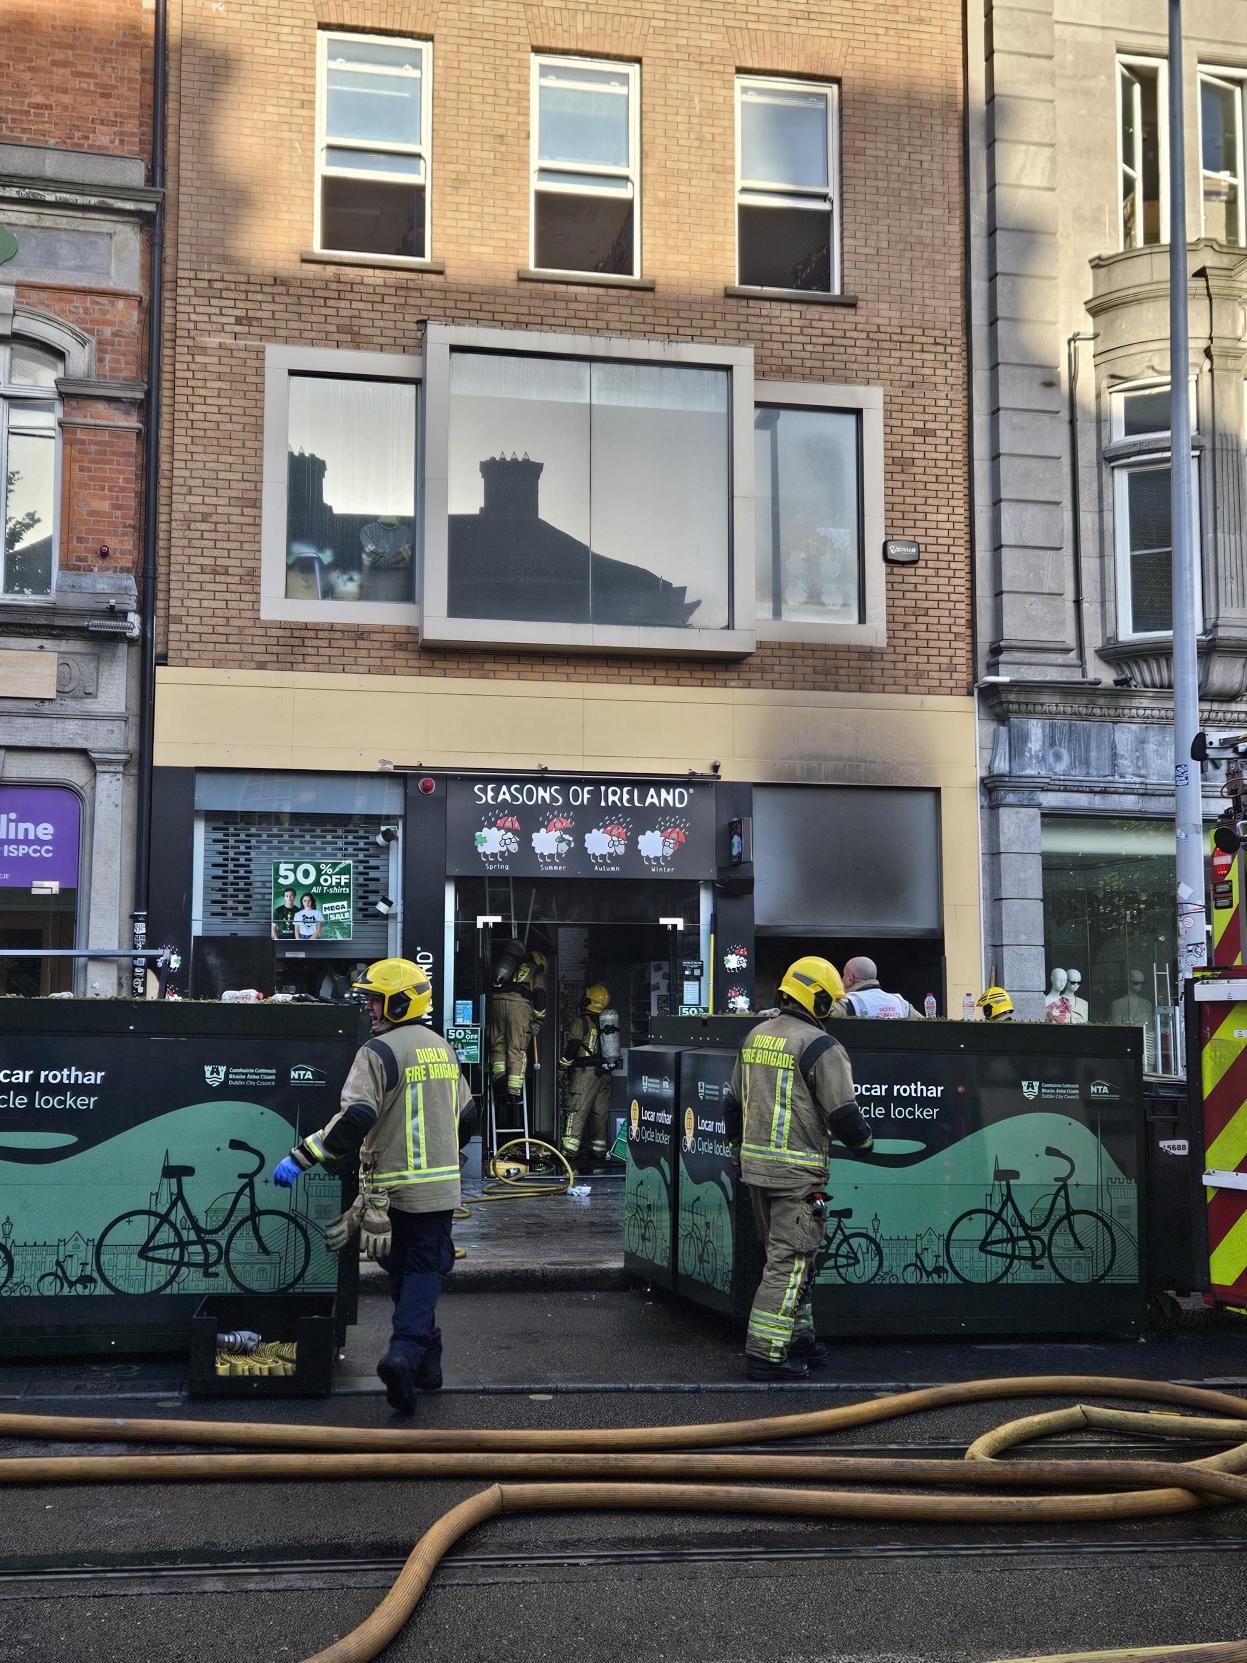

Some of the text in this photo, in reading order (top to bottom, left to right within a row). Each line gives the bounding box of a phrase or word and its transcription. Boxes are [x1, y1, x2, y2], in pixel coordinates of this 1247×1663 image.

[473, 784, 563, 806] SEASONS
[569, 785, 594, 805] OF
[3, 844, 53, 858] ISPCC
[485, 863, 509, 871] Spring
[320, 875, 350, 886] OFF
[311, 886, 350, 894] All T-shirts
[329, 912, 351, 921] SALE
[448, 1029, 465, 1039] 50
[752, 1034, 787, 1051] DUBLIN
[415, 1047, 449, 1064] DUBLIN
[755, 1049, 795, 1069] BRIGADE
[40, 1066, 105, 1085] rothar
[290, 1070, 313, 1080] NTA
[405, 1064, 427, 1084] FIRE
[893, 1081, 944, 1098] rothar
[1090, 1085, 1109, 1094] NTA
[35, 1090, 98, 1109] locker
[641, 1106, 672, 1125] Locar rothar
[858, 1102, 940, 1120] cle locker
[697, 1115, 714, 1132] Locar
[641, 1126, 671, 1145] Cycle locker
[697, 1137, 731, 1158] Cycle locke
